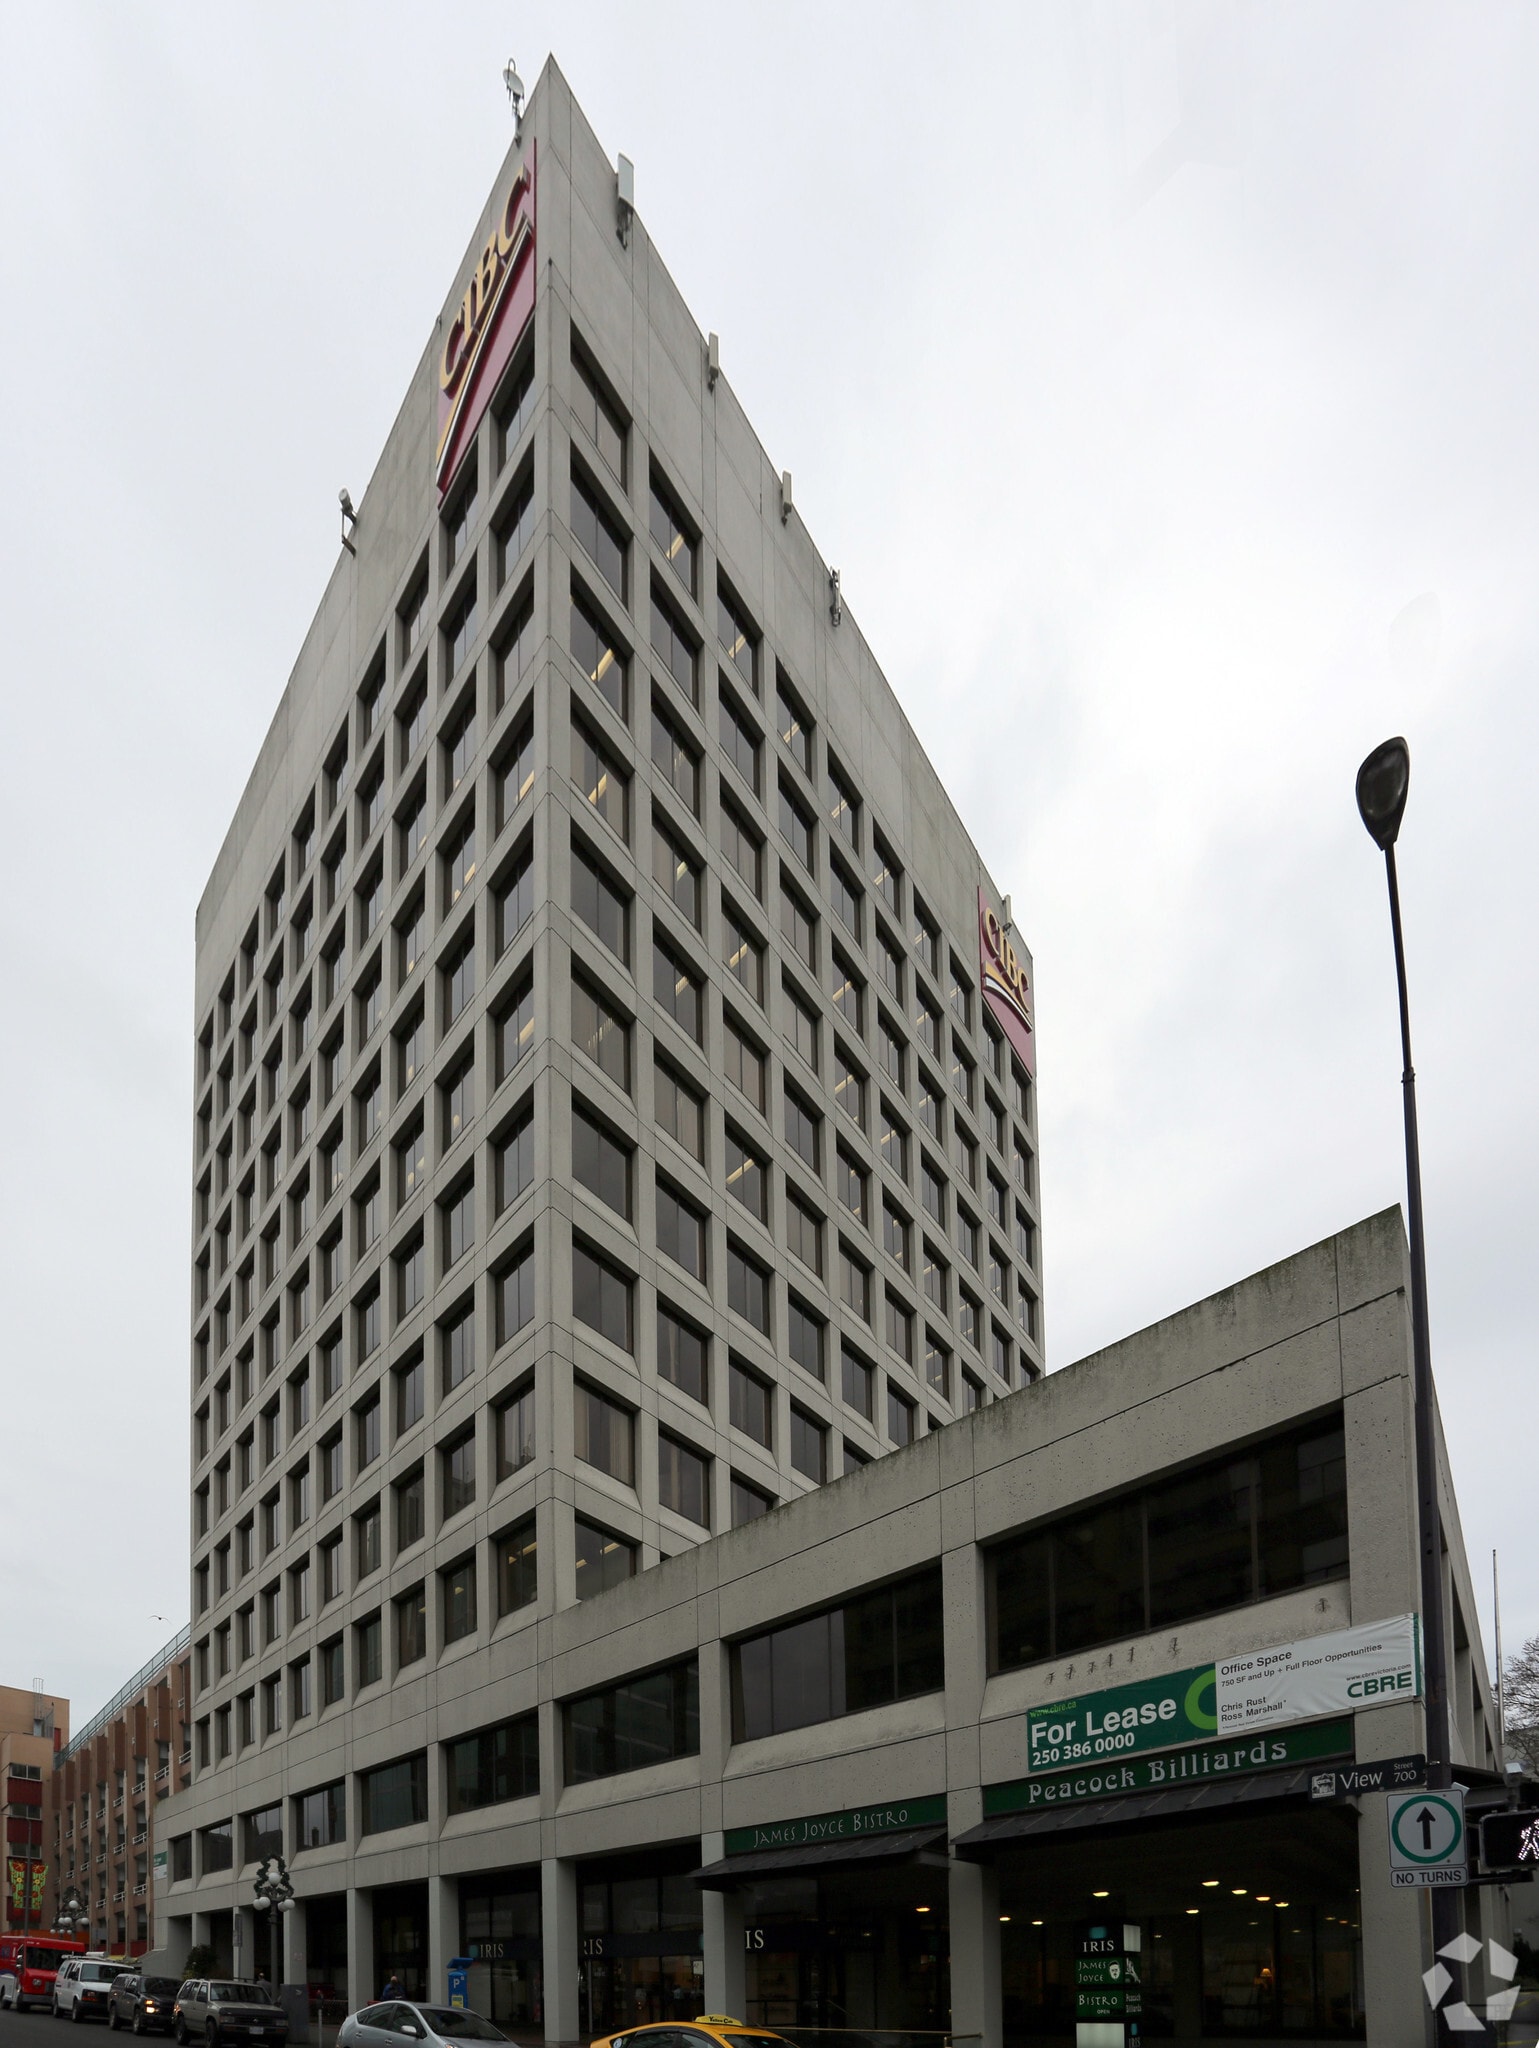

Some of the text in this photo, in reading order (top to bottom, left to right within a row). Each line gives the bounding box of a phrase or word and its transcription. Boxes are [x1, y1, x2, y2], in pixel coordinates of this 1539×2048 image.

[439, 162, 532, 398] CIBC
[982, 907, 1030, 1013] CIBC
[1221, 1651, 1292, 1676] Office Space
[1221, 1678, 1235, 1687] 750
[1236, 1675, 1246, 1684] SF
[1248, 1671, 1262, 1680] and
[1264, 1668, 1275, 1679] Up
[1285, 1662, 1300, 1672] Full
[1302, 1657, 1323, 1668] Floor
[1325, 1643, 1383, 1663] Opportunities
[1346, 1663, 1412, 1681] www.cbrevictoria.com
[1347, 1671, 1412, 1698] CBRE
[1221, 1696, 1266, 1713] Chris Rust
[1031, 1699, 1177, 1748] For Lease
[1221, 1711, 1243, 1722] Ross
[1032, 1732, 1135, 1766] 250 386 0000
[1028, 1741, 1288, 1804] Peacock Billiards
[1393, 1761, 1413, 1770] Street
[1340, 1770, 1417, 1790] View 700
[1396, 1870, 1462, 1884] NO TURNS
[480, 1943, 504, 1958] IRIS
[1083, 1940, 1115, 1953] IRIS
